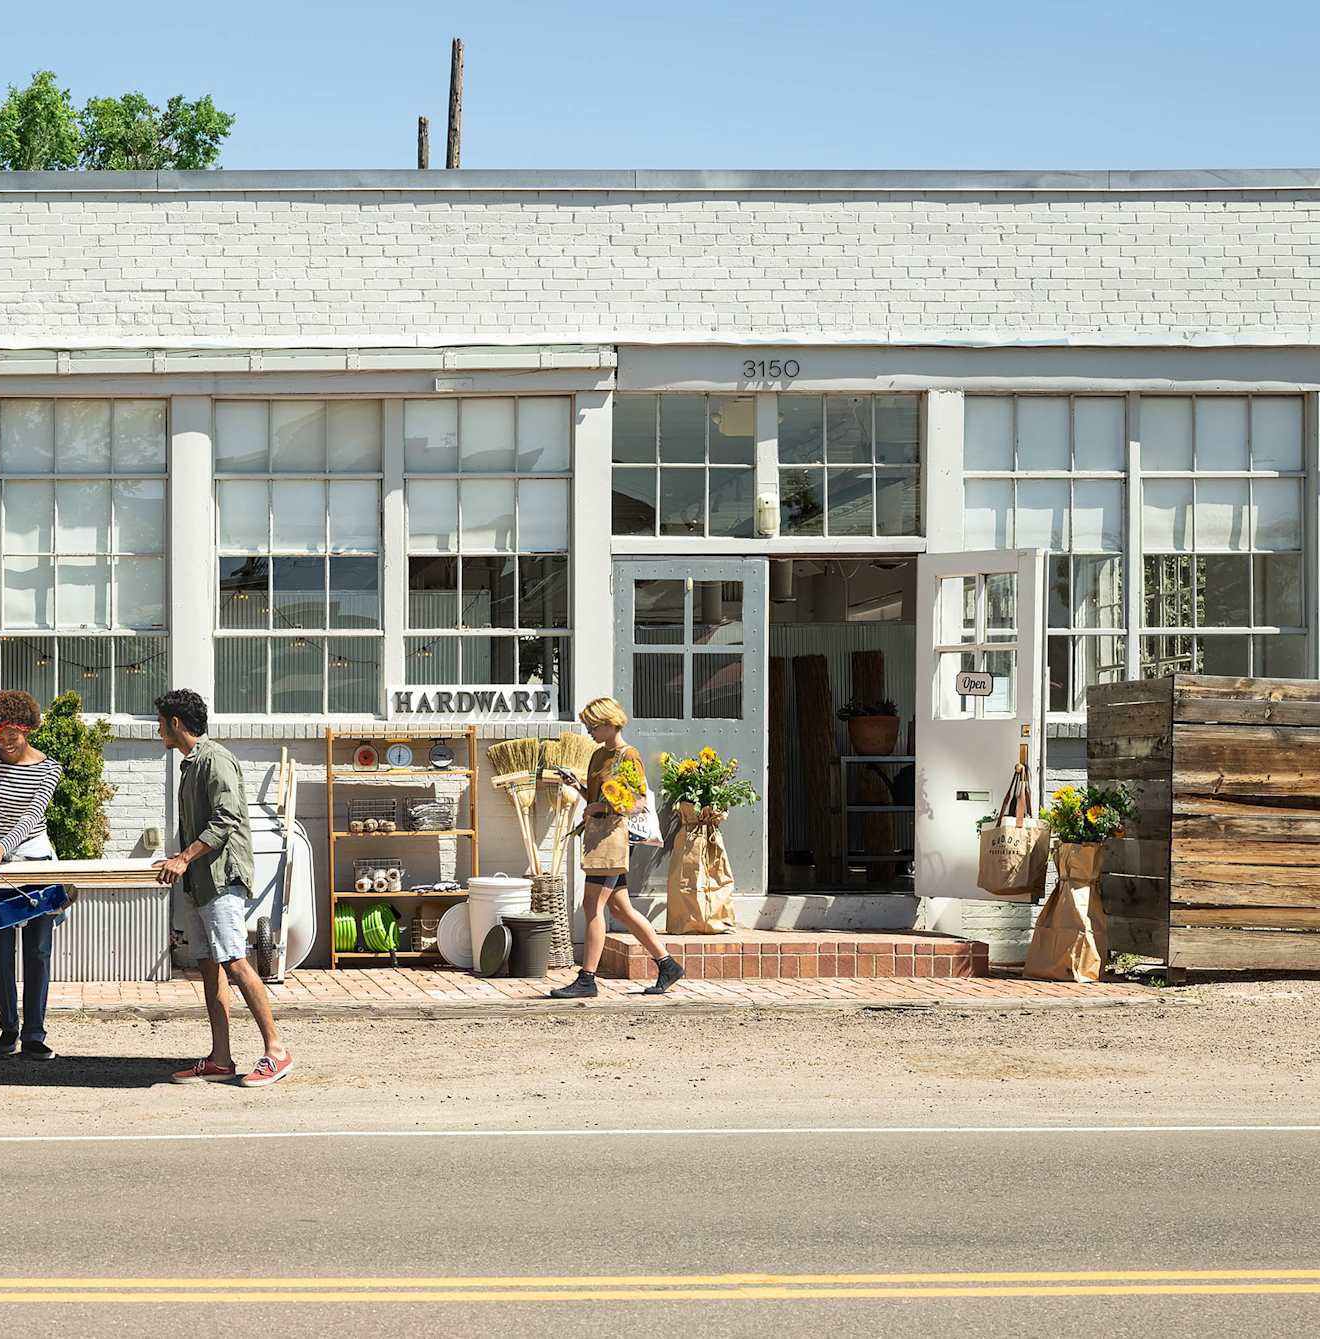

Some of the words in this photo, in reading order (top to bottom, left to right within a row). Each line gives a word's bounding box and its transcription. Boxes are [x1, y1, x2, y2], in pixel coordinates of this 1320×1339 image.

[743, 360, 800, 378] 3150
[962, 677, 986, 692] Open
[395, 691, 551, 713] HARDWARE
